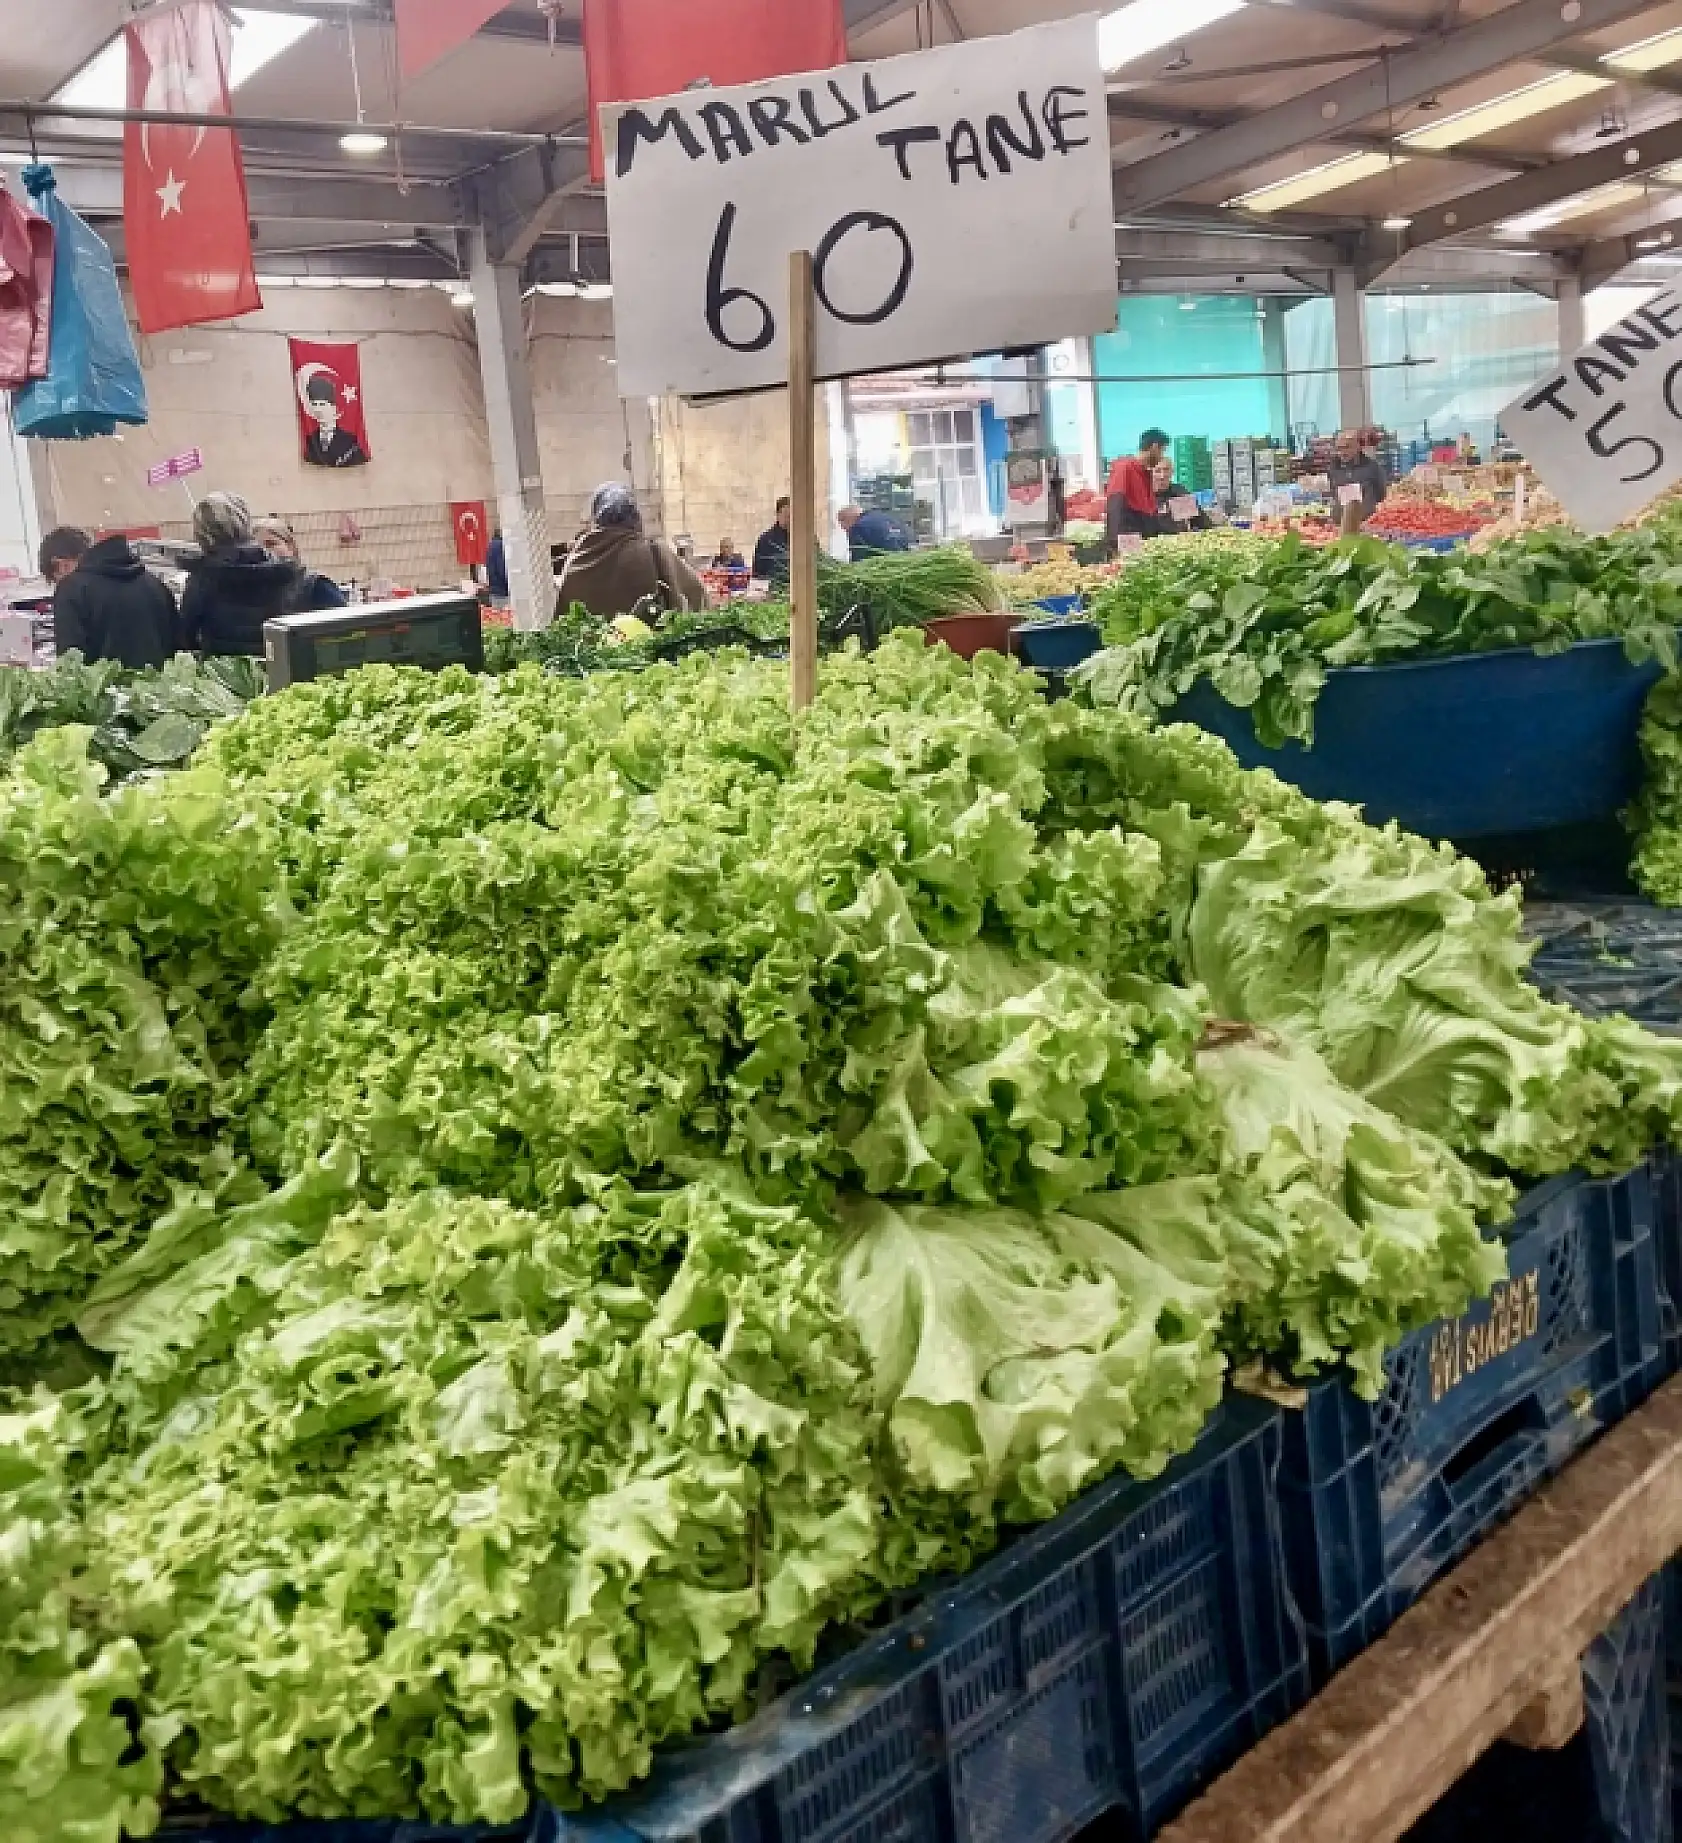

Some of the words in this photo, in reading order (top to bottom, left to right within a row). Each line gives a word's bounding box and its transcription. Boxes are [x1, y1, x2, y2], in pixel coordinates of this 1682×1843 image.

[616, 72, 917, 178] MARUL
[875, 86, 1091, 185] TANE
[705, 201, 914, 353] 60
[1521, 288, 1682, 422] TANE
